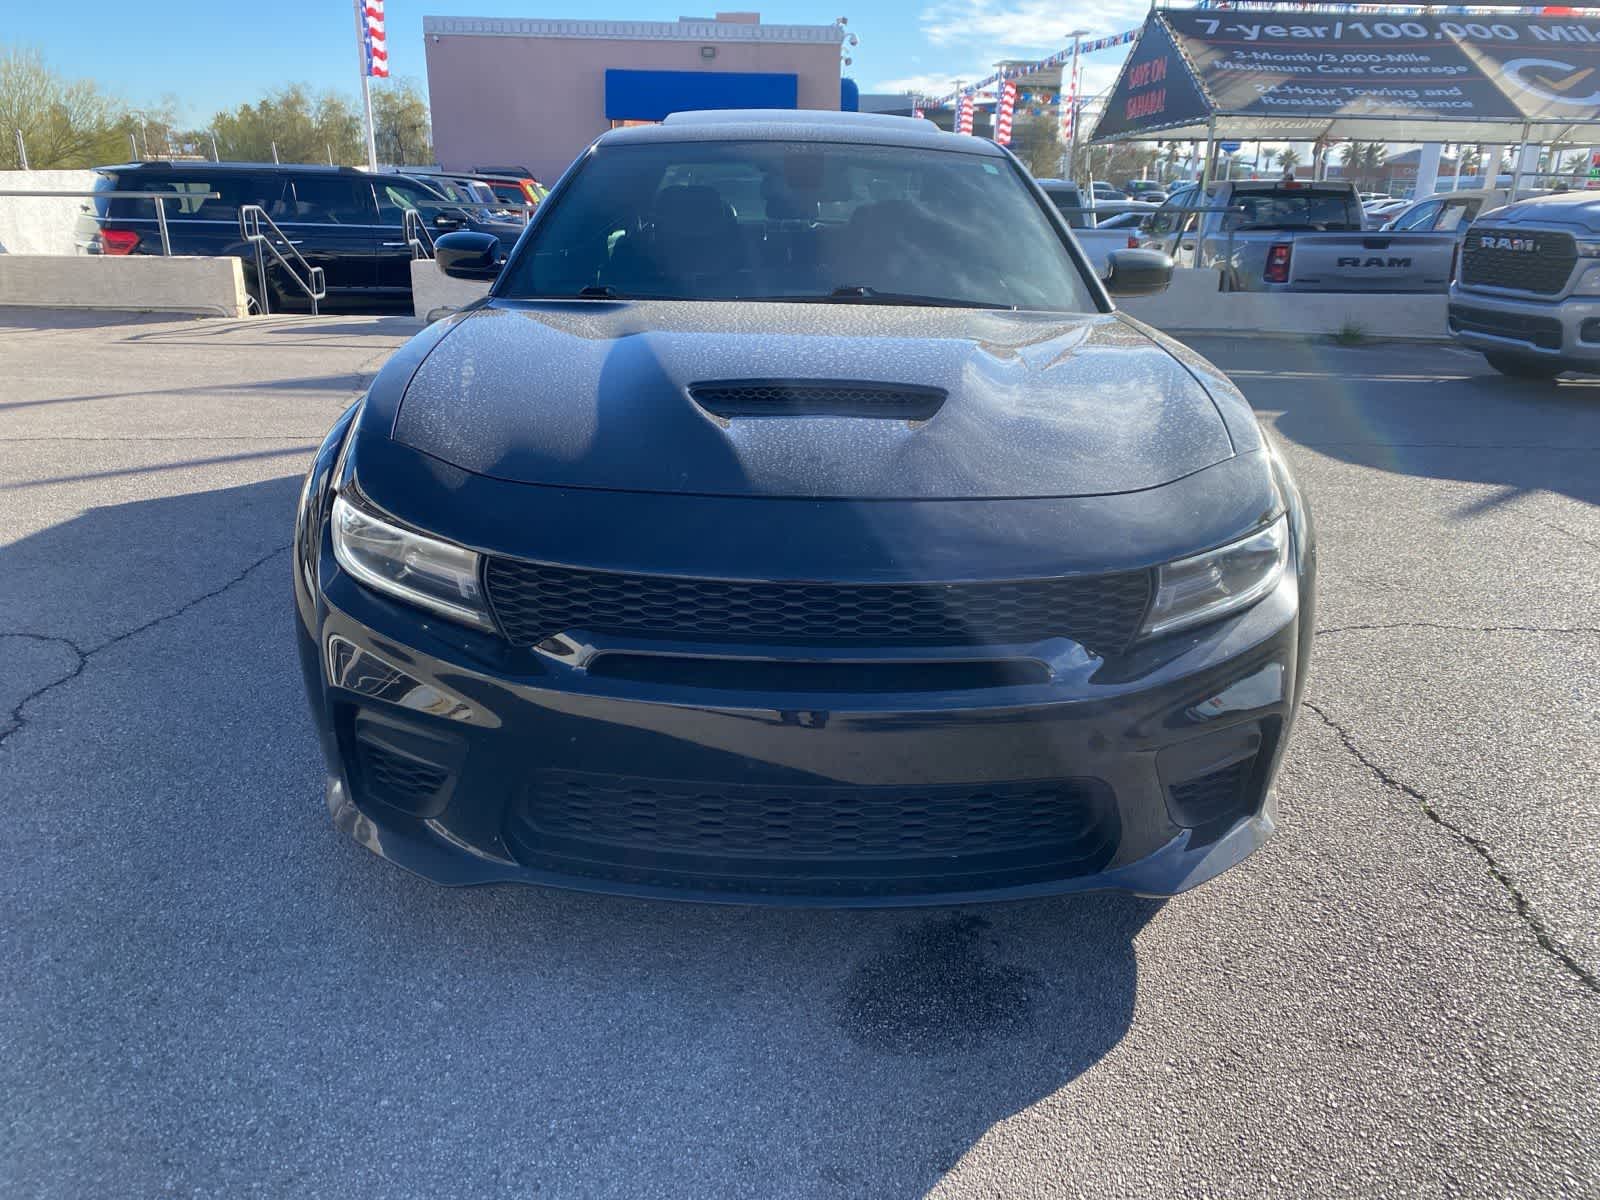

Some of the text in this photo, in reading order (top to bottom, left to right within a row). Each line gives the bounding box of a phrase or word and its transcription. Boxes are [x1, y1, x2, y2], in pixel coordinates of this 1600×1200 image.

[1195, 18, 1519, 41] 7-year/100,000
[1233, 50, 1431, 64] 3-Month/3,000-Mile
[1213, 60, 1469, 75] Maximum Care Coverage
[1255, 83, 1463, 99] 24-Hour Towing and
[1480, 235, 1535, 251] RAM
[1336, 256, 1412, 268] RAM
